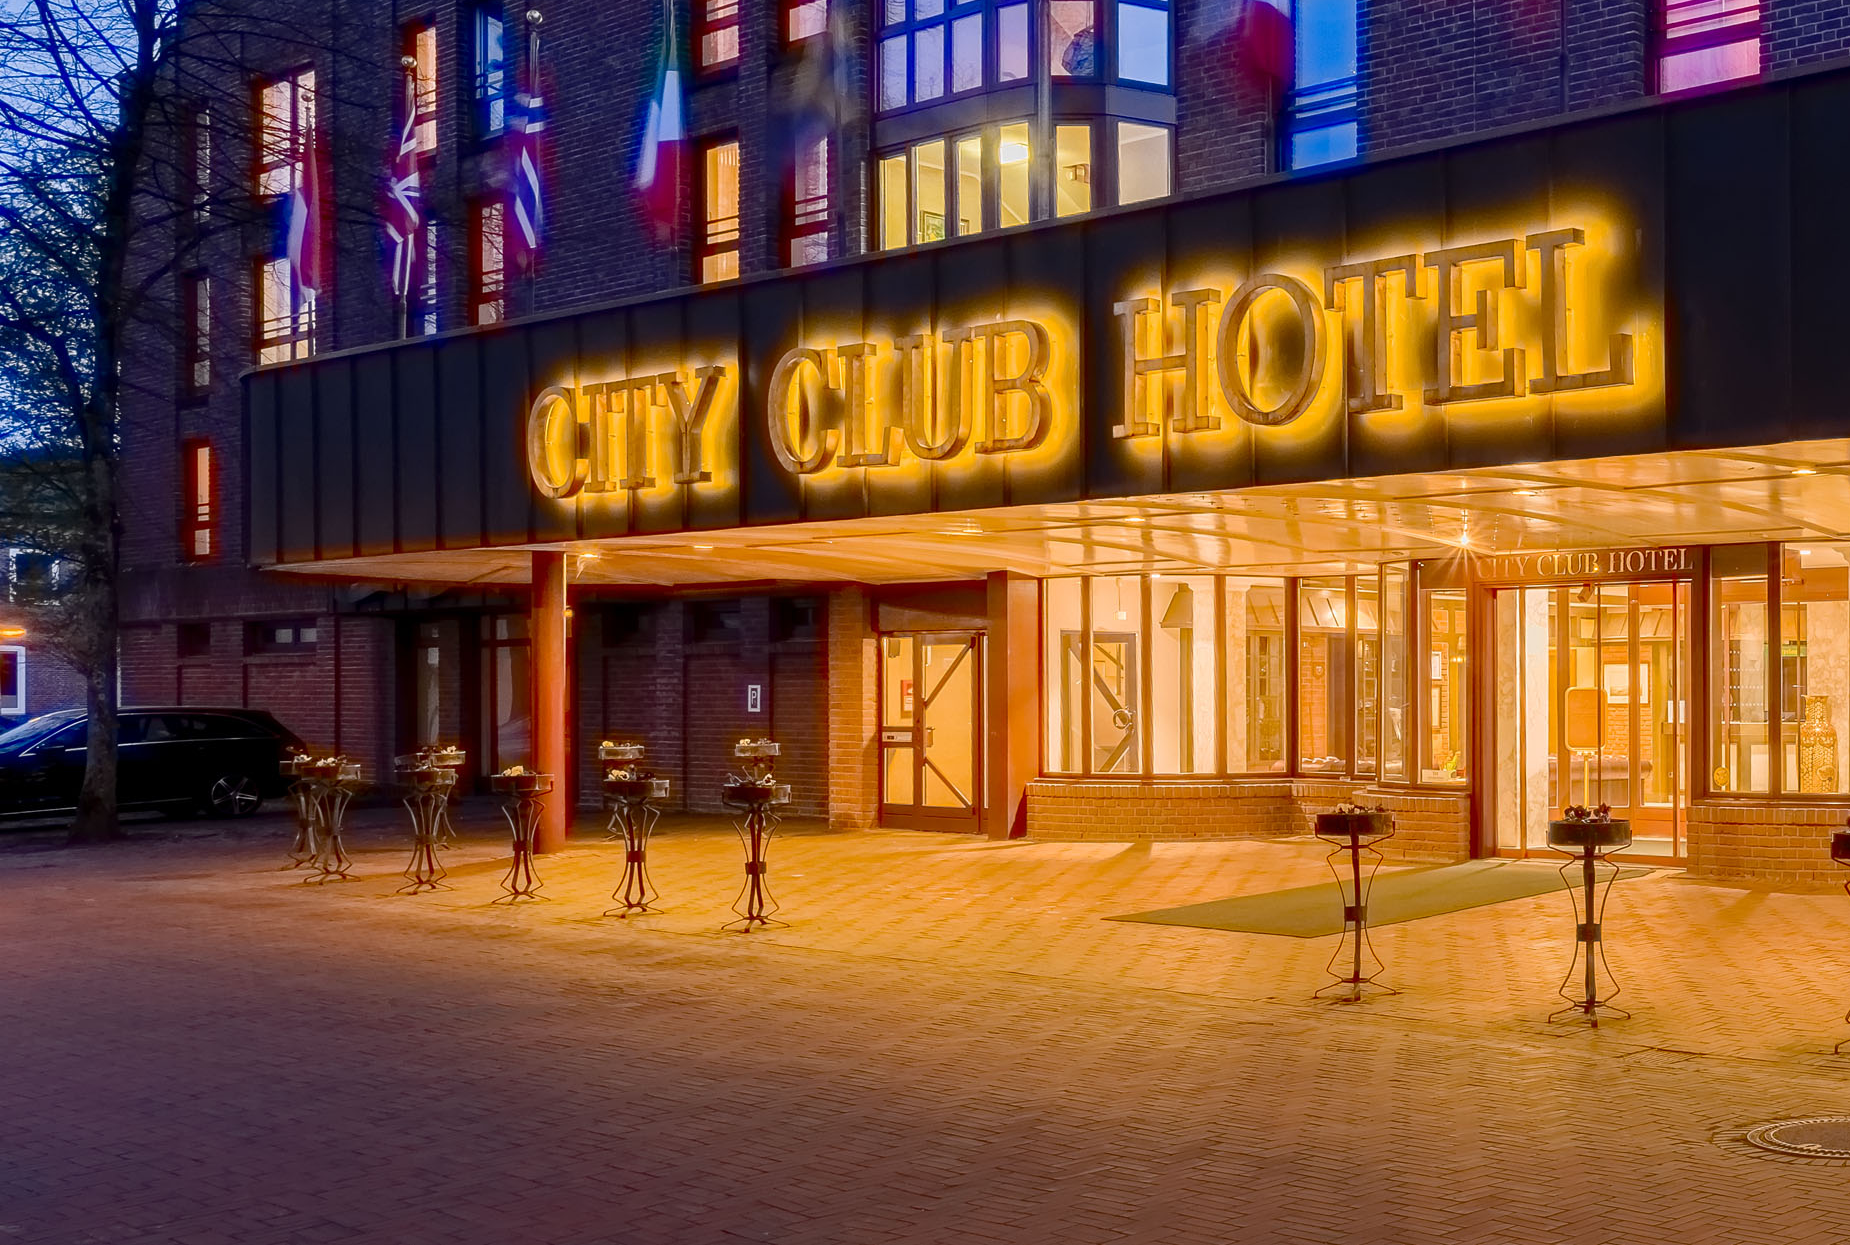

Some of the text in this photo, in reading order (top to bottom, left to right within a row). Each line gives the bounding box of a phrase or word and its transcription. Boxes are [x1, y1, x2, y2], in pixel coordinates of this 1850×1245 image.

[528, 227, 1634, 499] CITY CLUB HOTEL
[1476, 548, 1693, 579] CITY CLUB HOTEL
